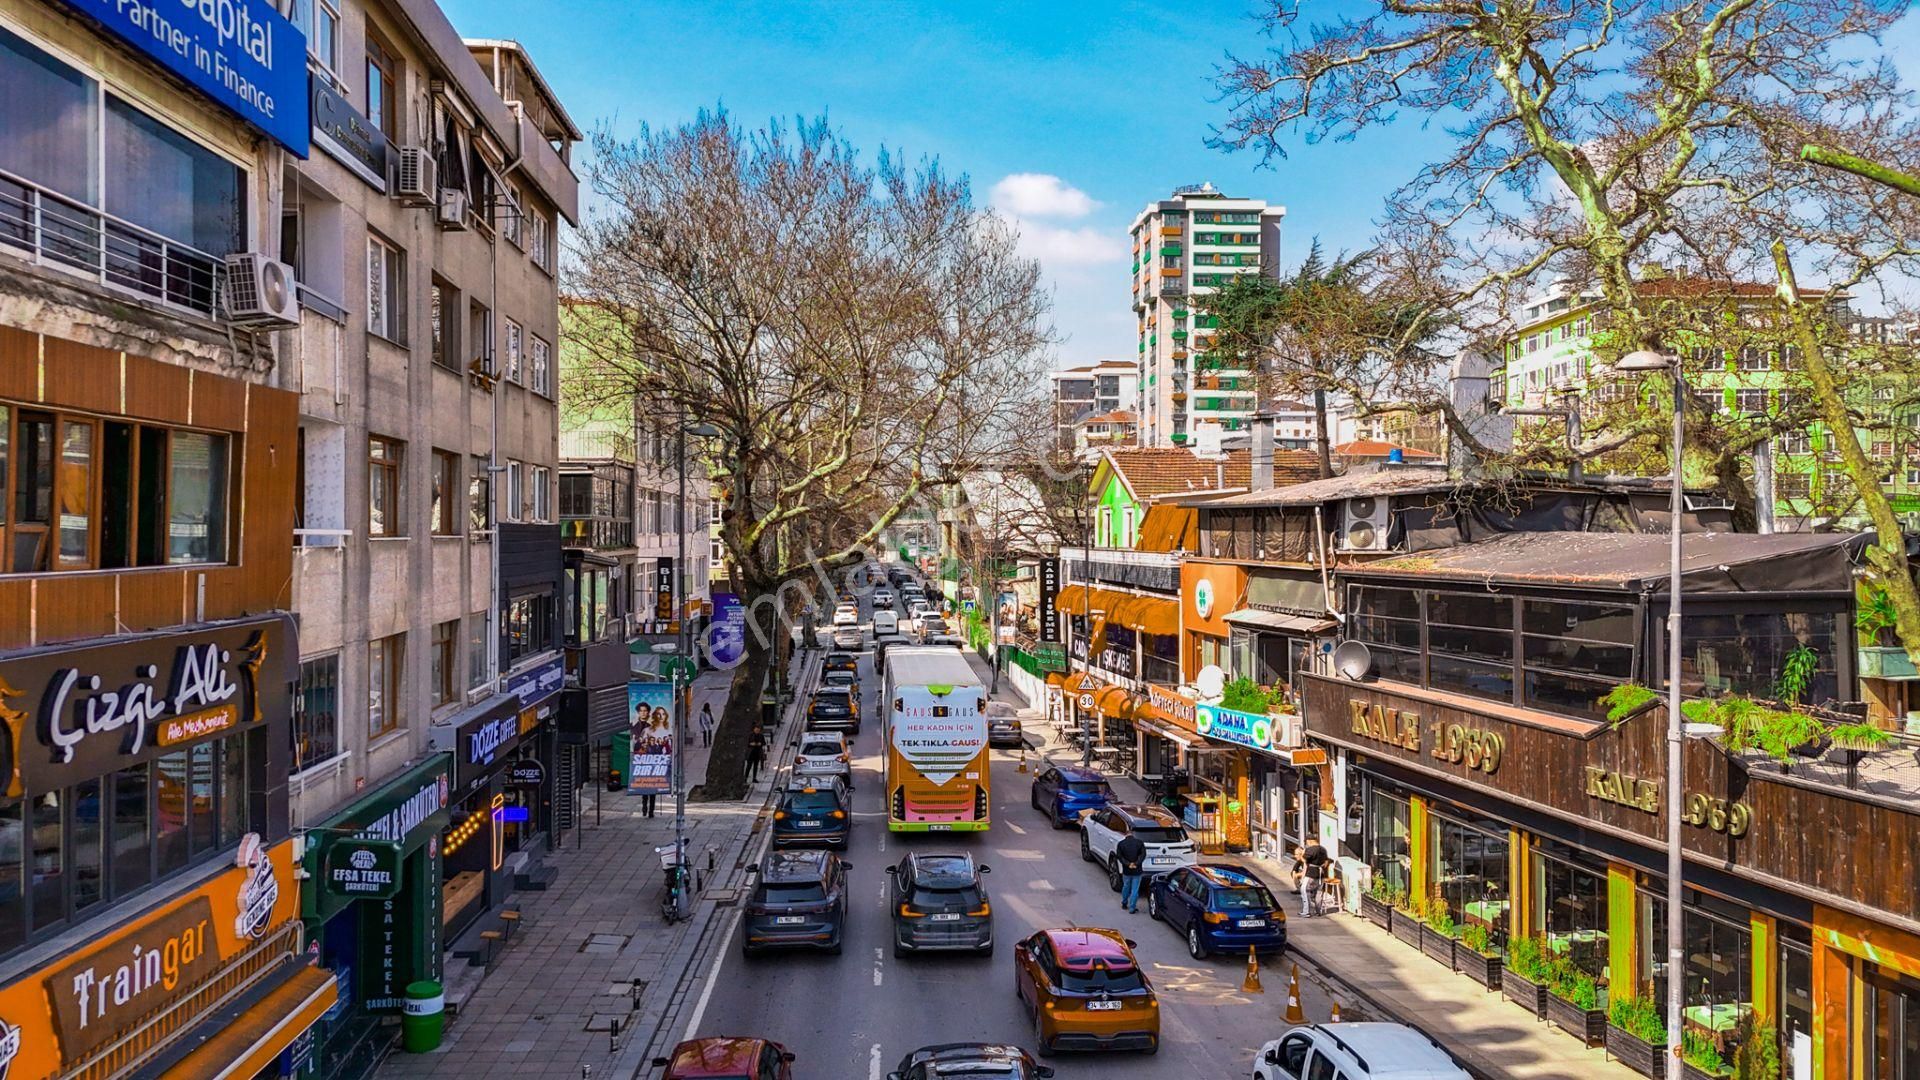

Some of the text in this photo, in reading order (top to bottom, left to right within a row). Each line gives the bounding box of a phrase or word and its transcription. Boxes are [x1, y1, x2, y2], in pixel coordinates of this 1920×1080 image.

[179, 0, 272, 71] apital
[195, 34, 211, 74] in
[215, 52, 274, 119] Finance
[51, 667, 166, 764] Çizgi
[175, 643, 237, 715] Ali
[906, 707, 933, 717] GAUS
[948, 707, 974, 717] GAUS
[1081, 696, 1094, 707] 30
[901, 739, 919, 747] TEK
[922, 739, 949, 747] TIKLA
[1349, 699, 1502, 774] KALE 1969
[632, 754, 670, 765] SADECE
[652, 765, 668, 776] AN
[1585, 765, 1660, 813] KALE
[393, 808, 399, 841] &
[400, 776, 440, 844] ŞARKÜTERİ
[333, 869, 391, 883] EFSA TEKEL
[345, 882, 380, 892] ŞARKÜTERİ
[384, 901, 393, 994] SA TEKEL
[73, 919, 208, 1029] Traingar
[366, 998, 405, 1010] ŞARKÜTE
